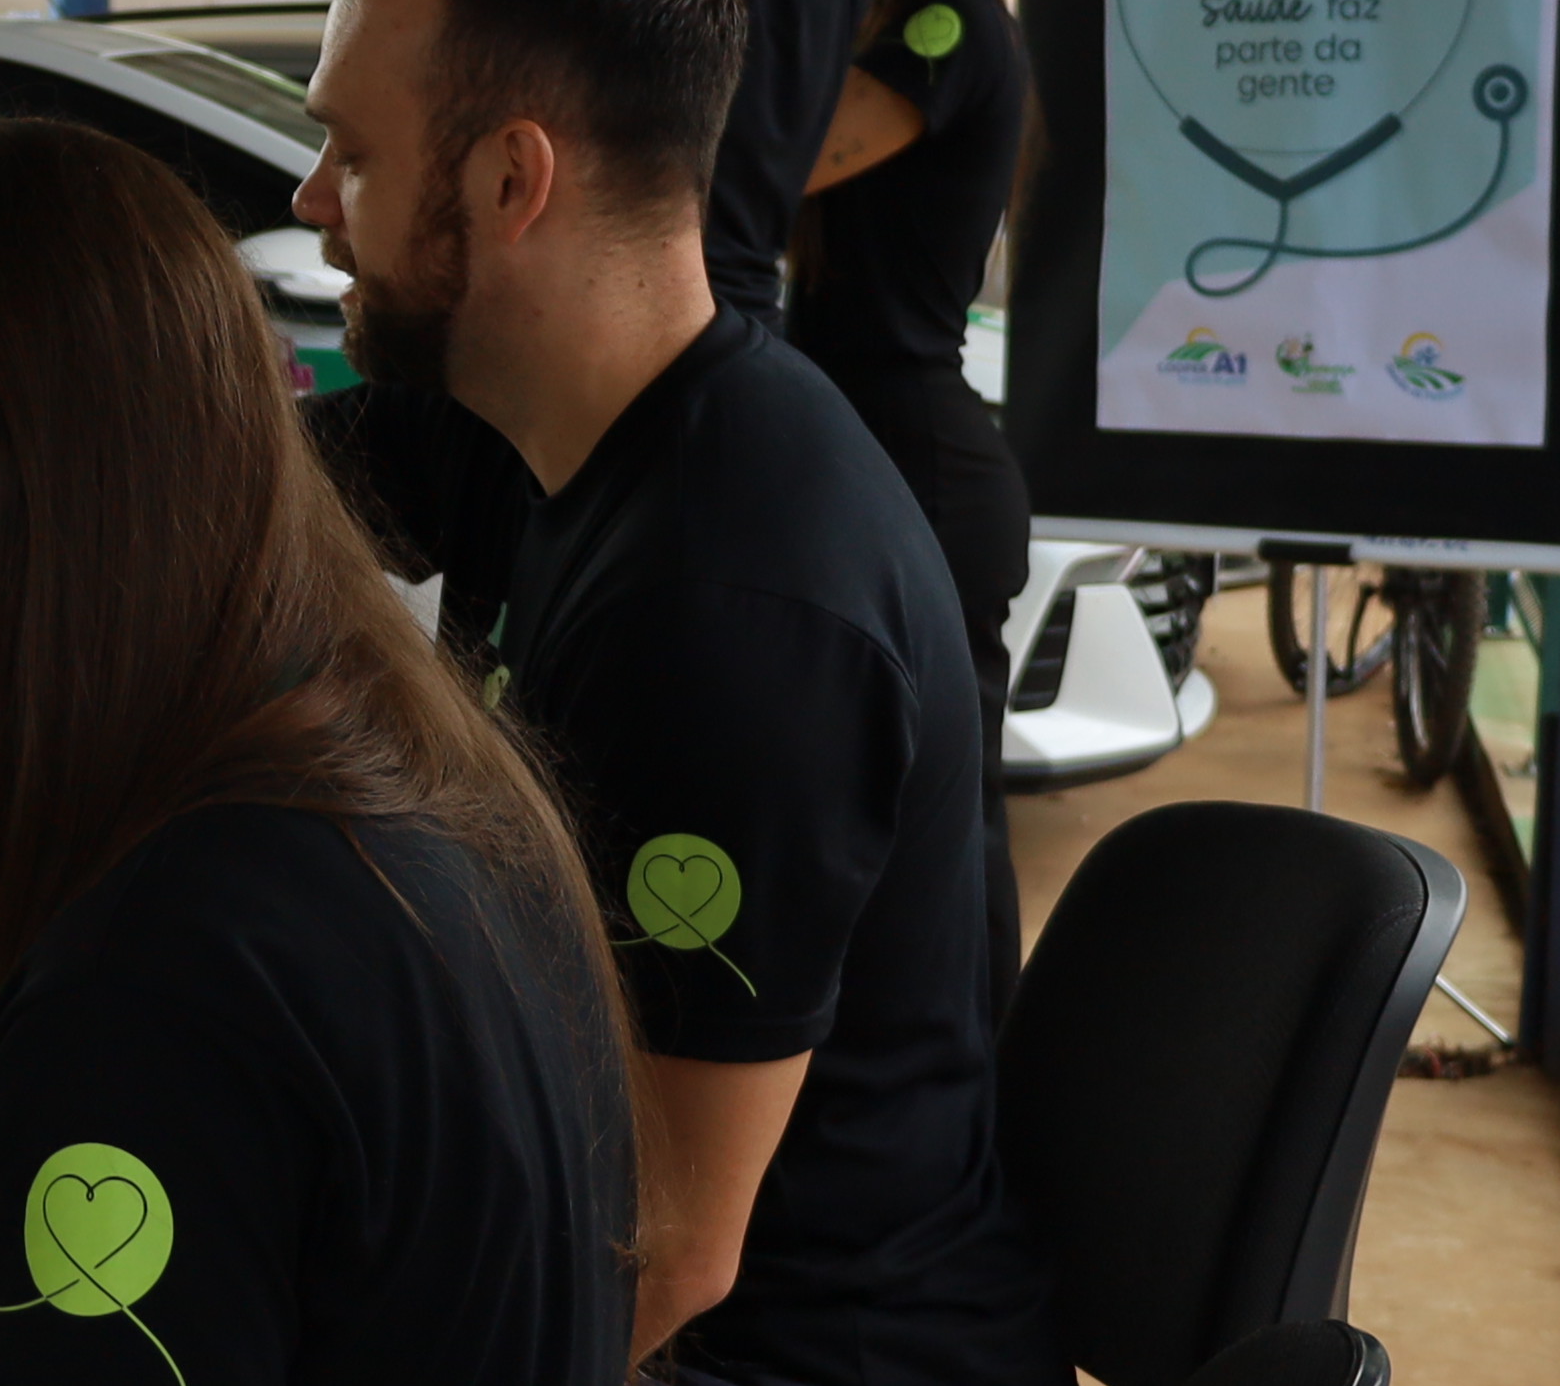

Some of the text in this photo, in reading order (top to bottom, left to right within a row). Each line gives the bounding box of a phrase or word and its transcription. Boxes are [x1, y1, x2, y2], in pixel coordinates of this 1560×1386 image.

[1215, 34, 1361, 69] parte da
[1237, 71, 1335, 104] gente
